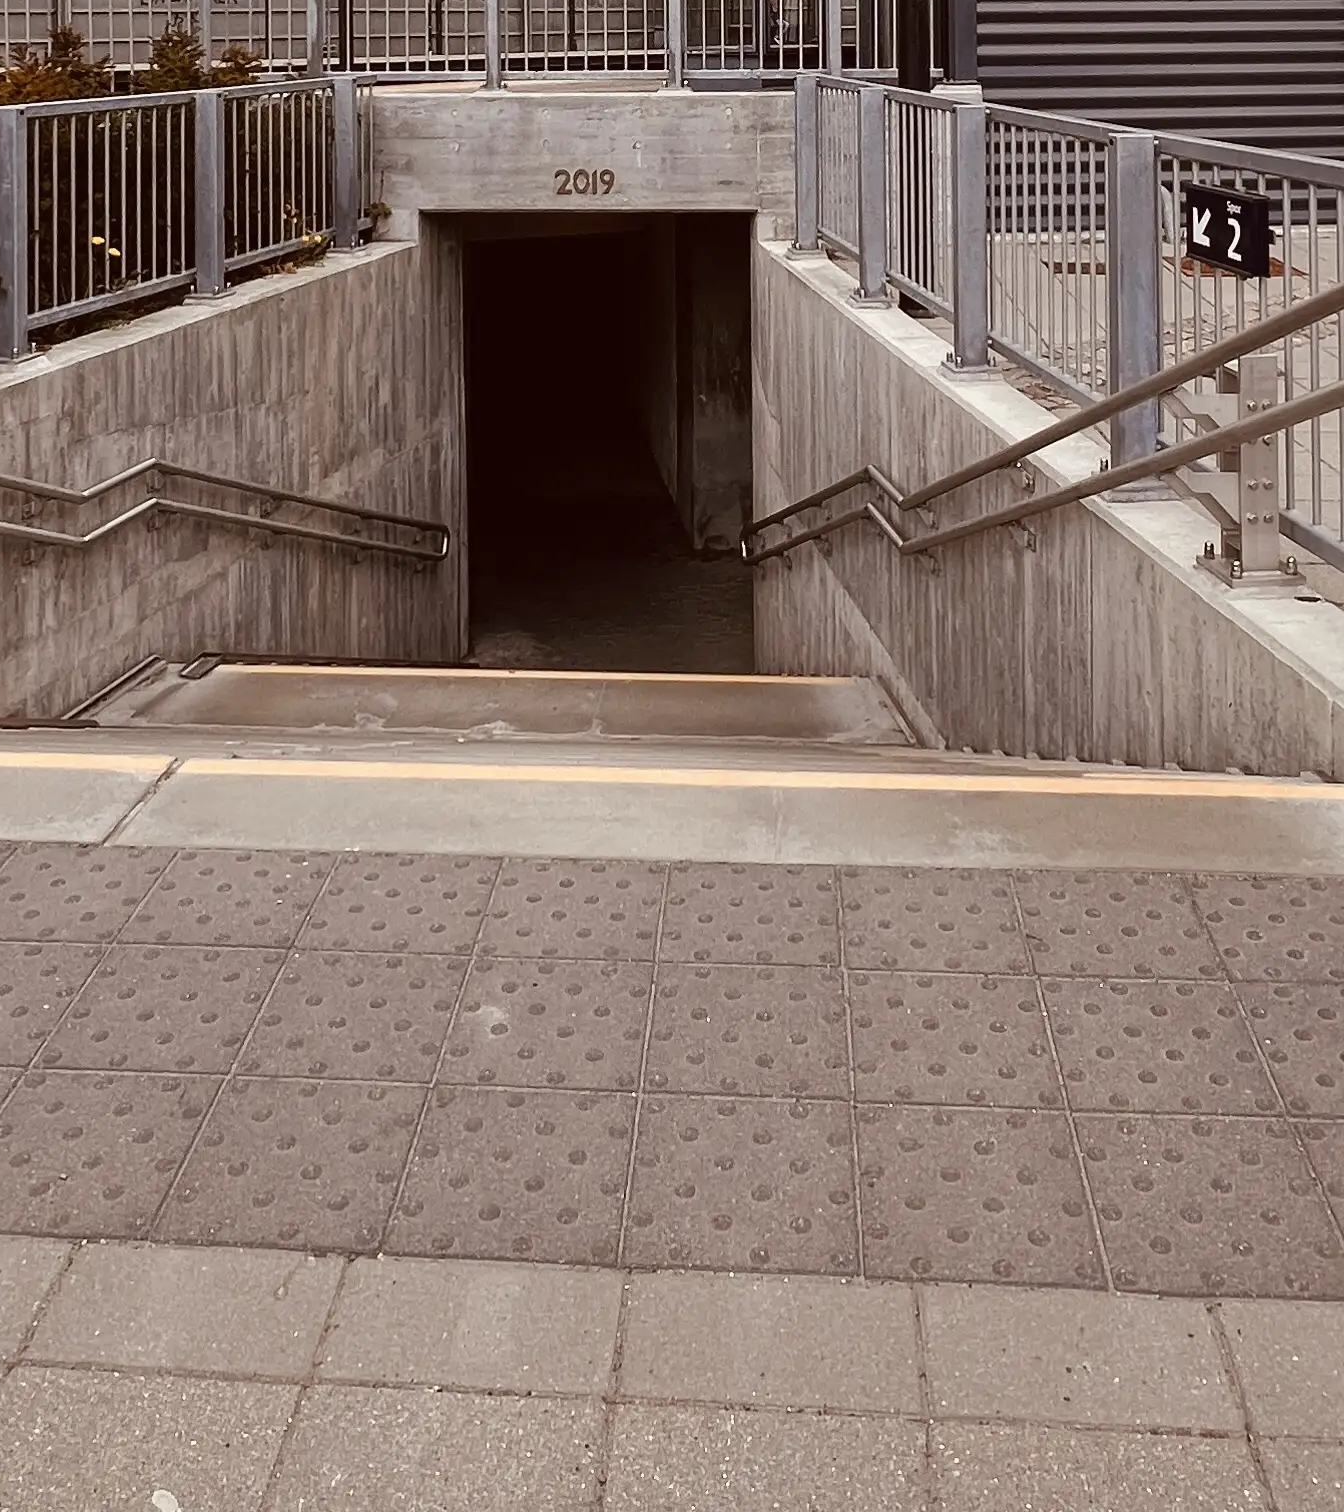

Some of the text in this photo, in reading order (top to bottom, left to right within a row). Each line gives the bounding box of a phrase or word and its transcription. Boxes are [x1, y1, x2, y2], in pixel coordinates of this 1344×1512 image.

[555, 169, 615, 195] 2019
[1227, 201, 1241, 214] Spor
[1227, 218, 1242, 262] 2
